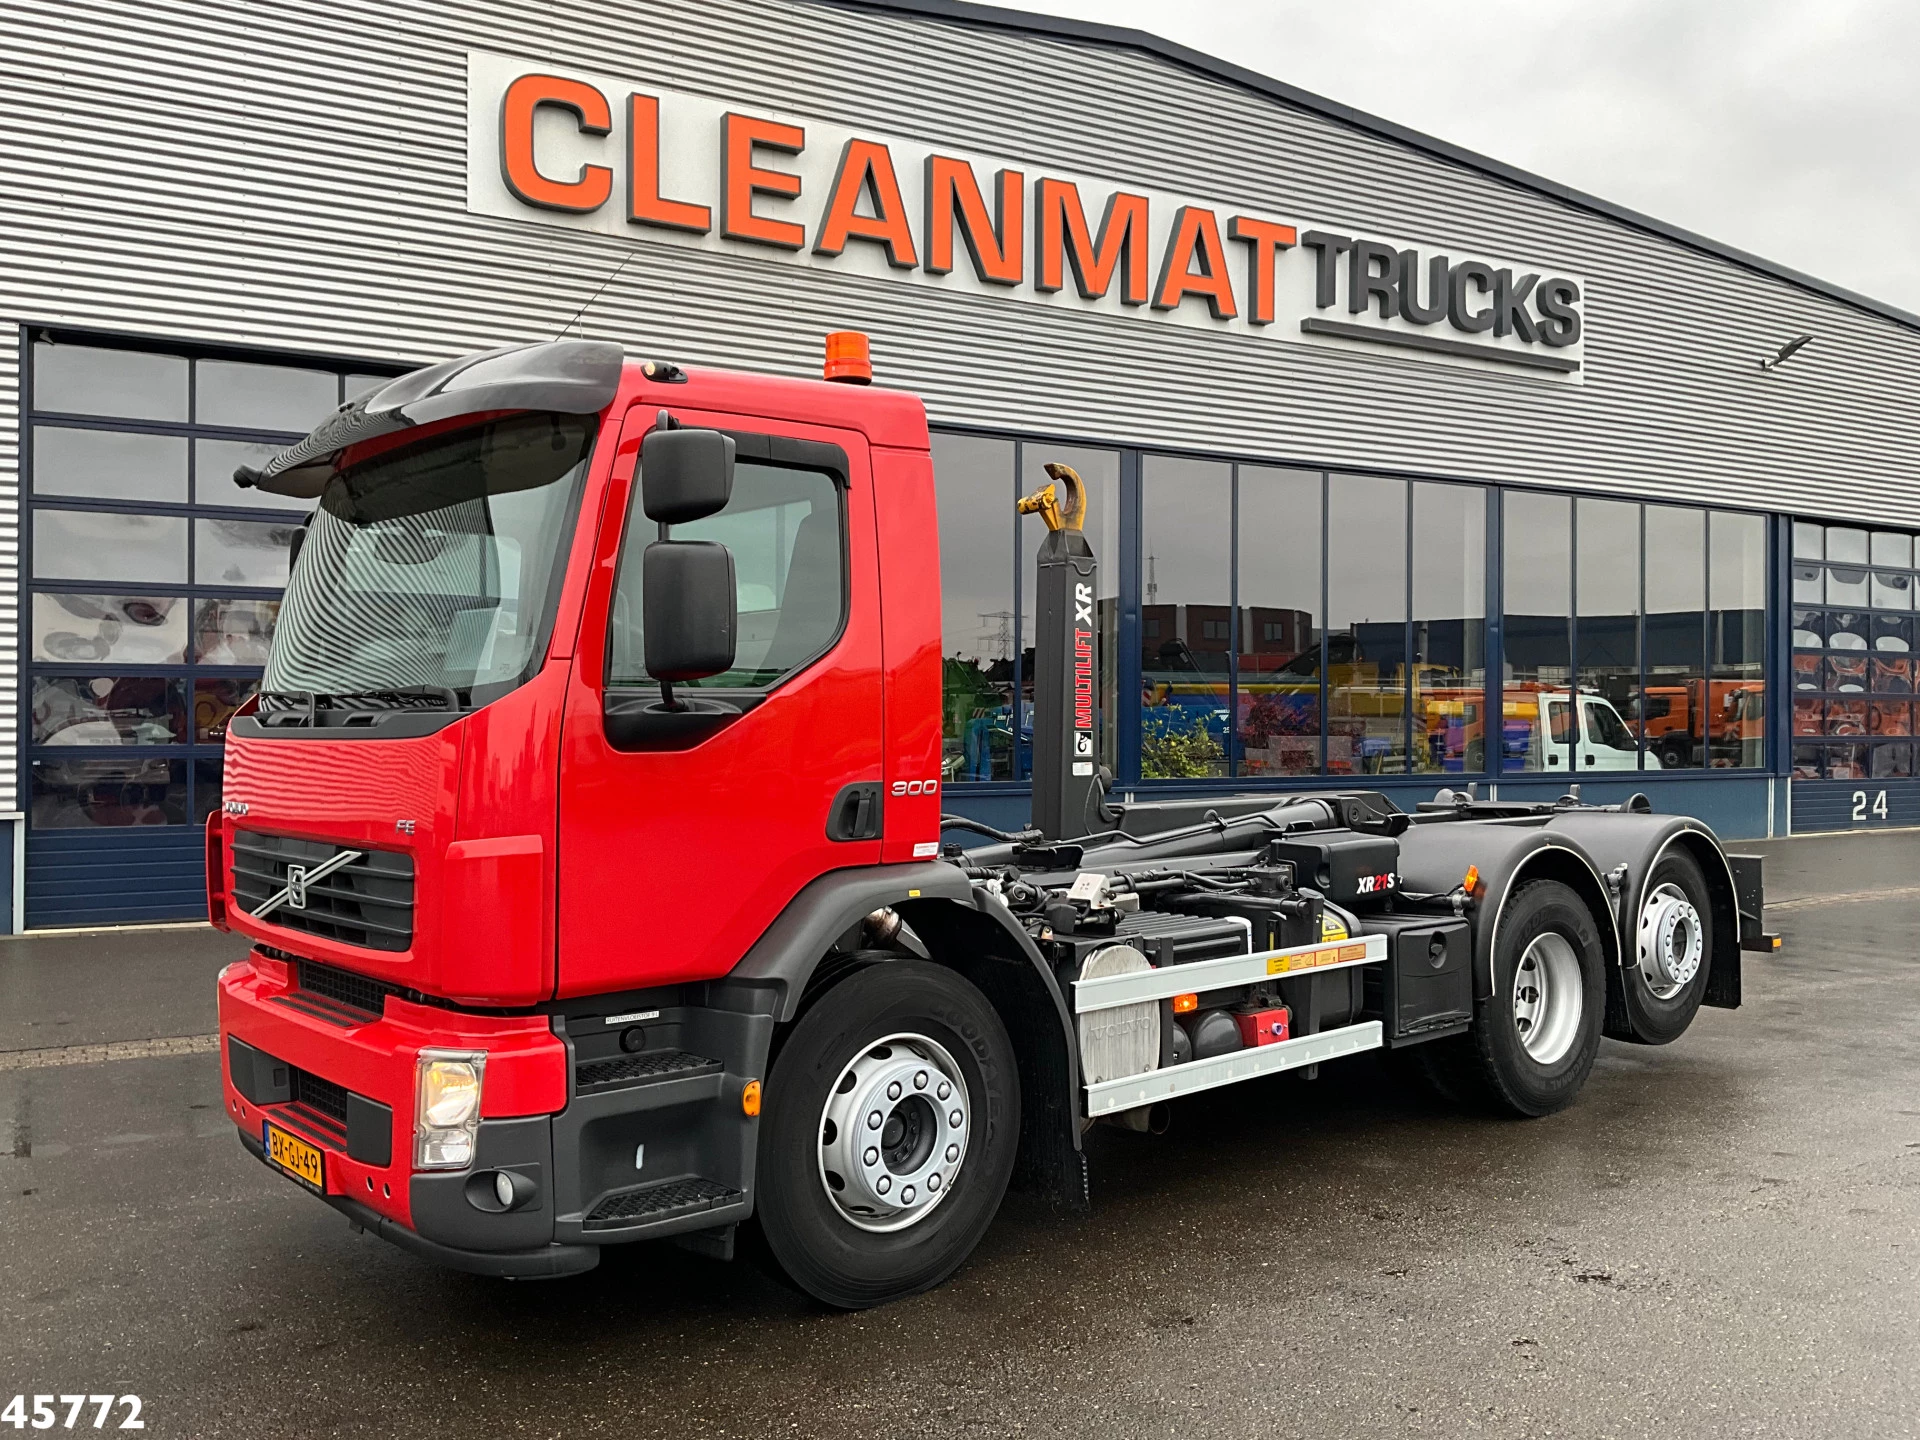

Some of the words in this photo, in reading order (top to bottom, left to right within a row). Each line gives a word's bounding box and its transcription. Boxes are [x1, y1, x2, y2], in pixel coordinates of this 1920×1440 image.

[500, 73, 1297, 326] CLEANMAT
[1302, 229, 1581, 347] TRUCKS
[1075, 583, 1092, 627] XR
[1075, 628, 1092, 728] MULTILIFT
[891, 780, 938, 796] 300
[1853, 790, 1888, 820] 24
[396, 820, 416, 835] FE
[1356, 872, 1395, 894] XR21S
[1514, 904, 1590, 949] GOODAR
[1090, 1016, 1151, 1041] VOLVO
[272, 1131, 318, 1178] BX-GJ-49
